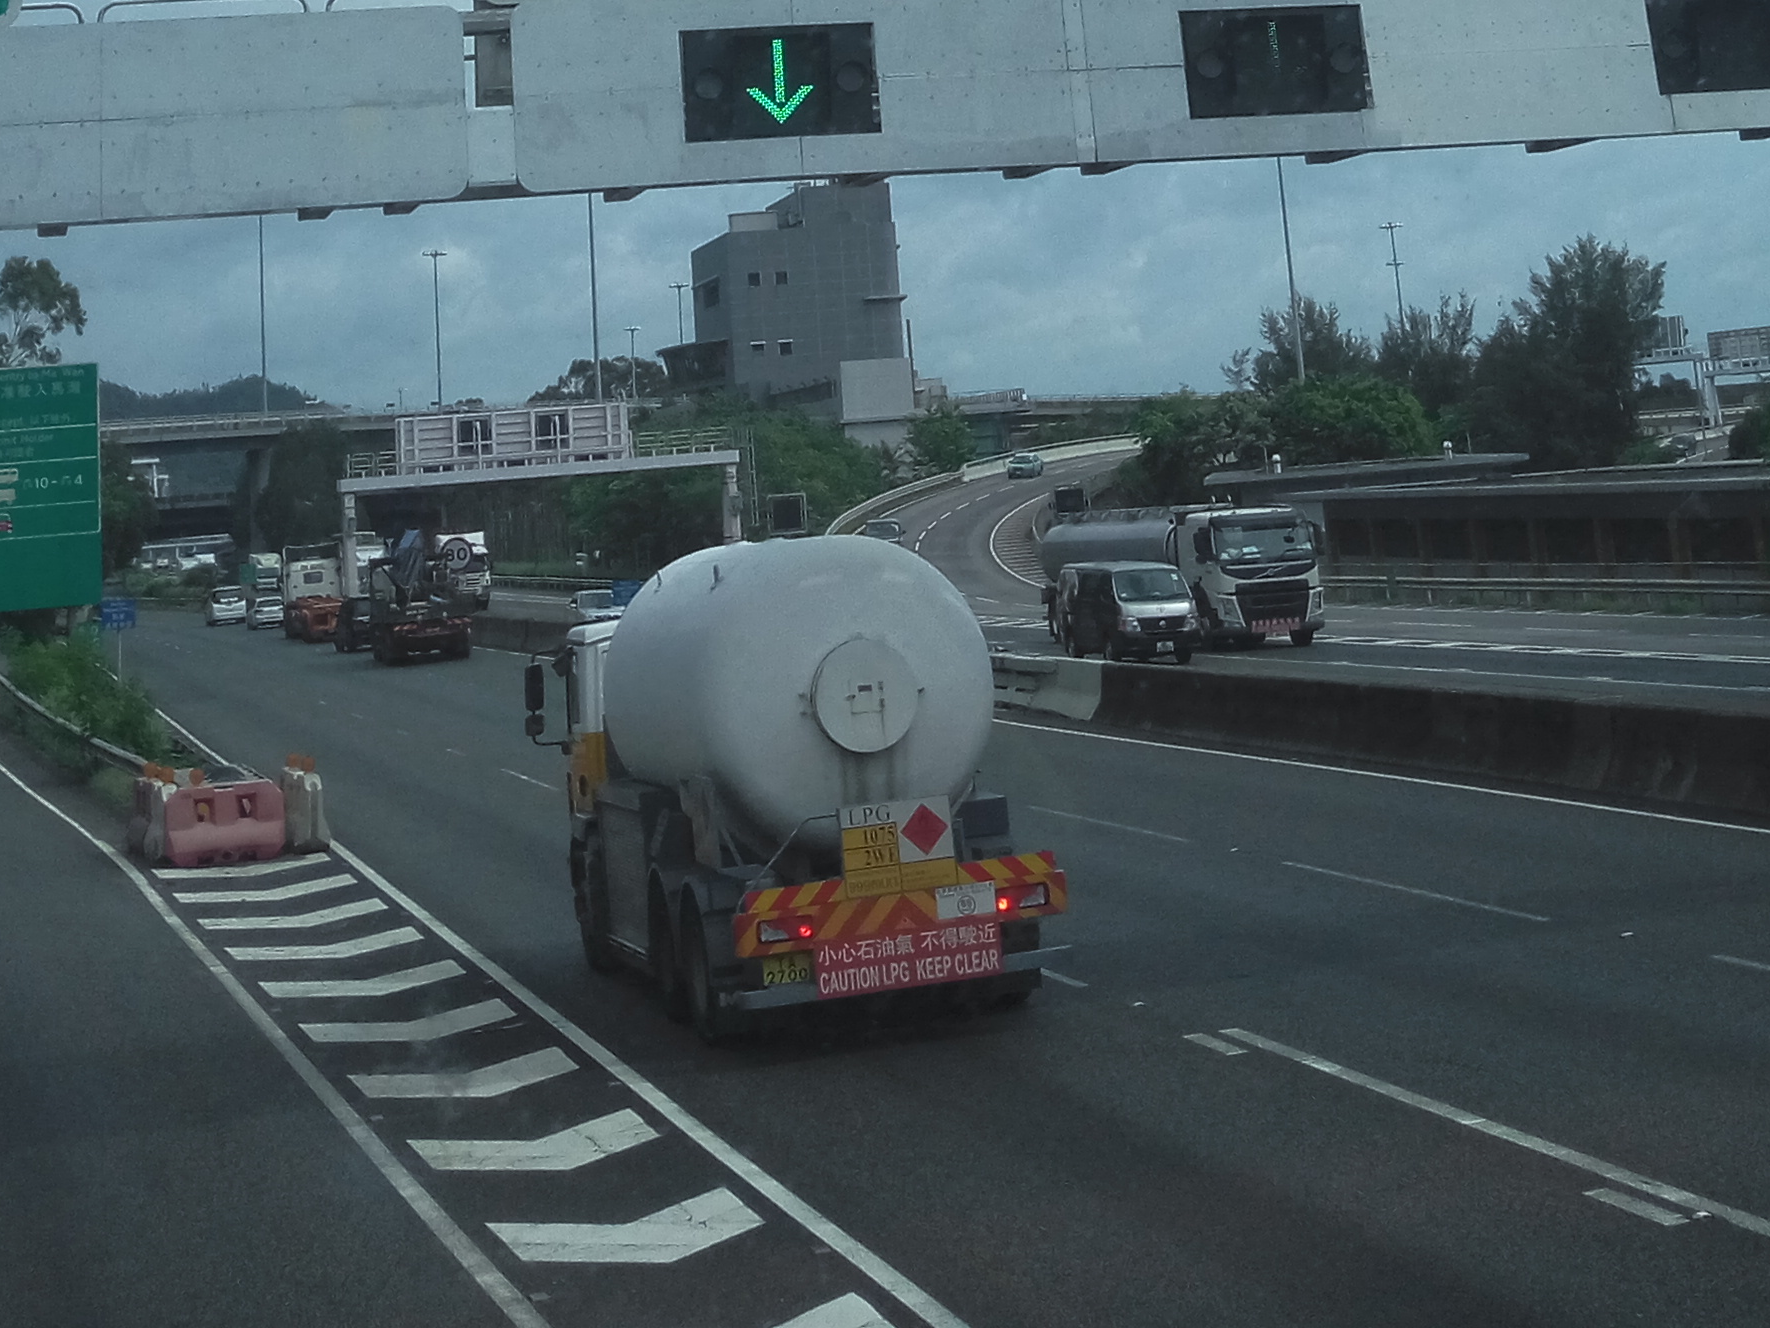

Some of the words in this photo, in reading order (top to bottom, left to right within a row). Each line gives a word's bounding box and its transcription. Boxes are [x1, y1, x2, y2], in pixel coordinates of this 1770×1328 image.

[849, 804, 891, 826] LPG
[863, 825, 895, 845] 1075
[818, 933, 915, 966] 小心石油氣
[920, 922, 997, 952] 不得駛近
[766, 968, 809, 984] 2700
[819, 966, 880, 994] CAUTION
[882, 961, 910, 986] LPG
[916, 957, 952, 981] KEEP
[955, 949, 999, 976] CLEAR
